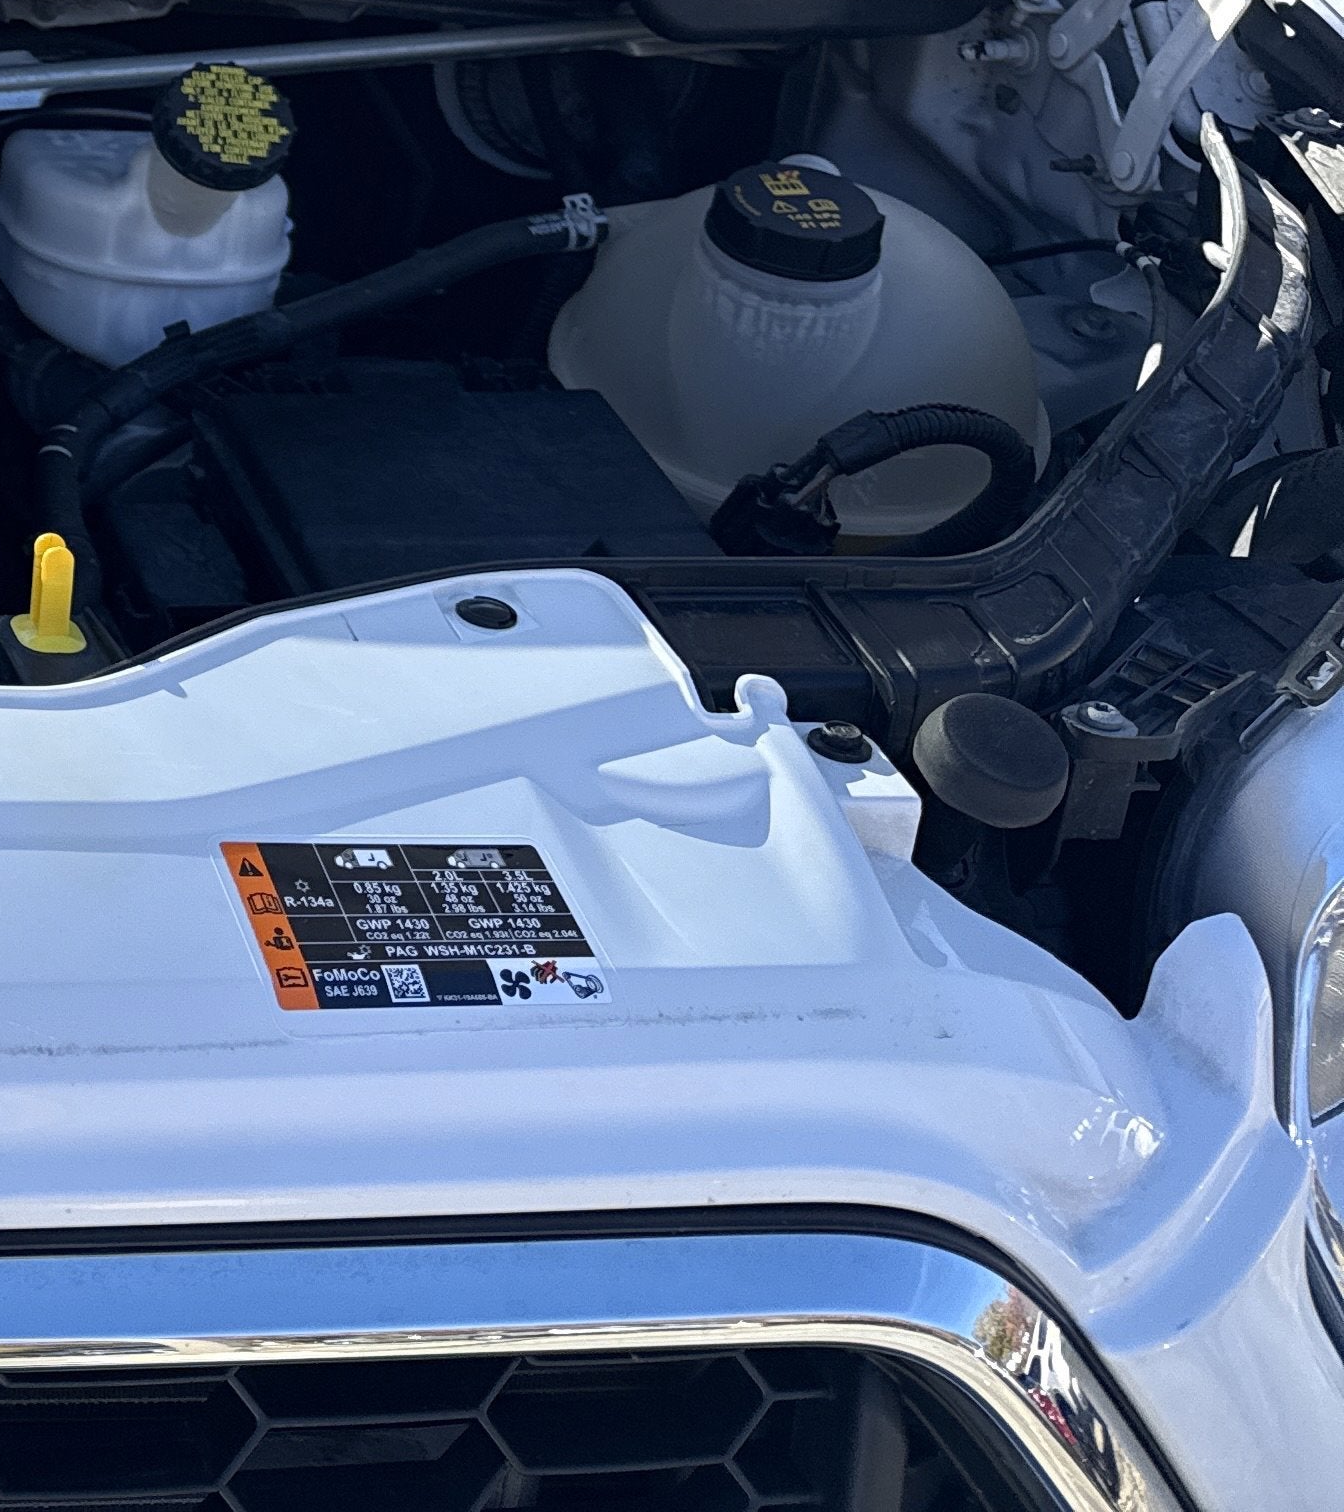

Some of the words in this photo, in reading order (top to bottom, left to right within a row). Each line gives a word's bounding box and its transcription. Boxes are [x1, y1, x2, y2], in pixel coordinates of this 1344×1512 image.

[432, 870, 463, 881] 2.0L
[502, 870, 533, 881] 3.5L
[353, 882, 381, 893] 0.85
[382, 882, 402, 896] kg
[431, 882, 458, 893] 1.35
[459, 882, 478, 896] kg
[496, 882, 530, 893] 1.425
[531, 882, 551, 896] kg
[284, 896, 334, 907] R-134a
[513, 894, 528, 903] 50
[390, 904, 408, 913] lbs
[468, 904, 486, 913] lbs
[512, 904, 536, 913] 3.14
[537, 904, 555, 913] lbs
[356, 919, 391, 929] GWP
[396, 919, 430, 929] 1430
[468, 918, 503, 928] GWP
[507, 918, 541, 928] 1430
[445, 931, 468, 939] CO2
[470, 932, 484, 940] eq
[514, 930, 537, 938] CO2
[539, 932, 552, 940] eq
[385, 945, 419, 957] PAG
[423, 944, 536, 956] WSH-M1C231-B
[312, 968, 380, 981] FoMoCo
[325, 986, 349, 997] SAE
[352, 985, 378, 996] J639
